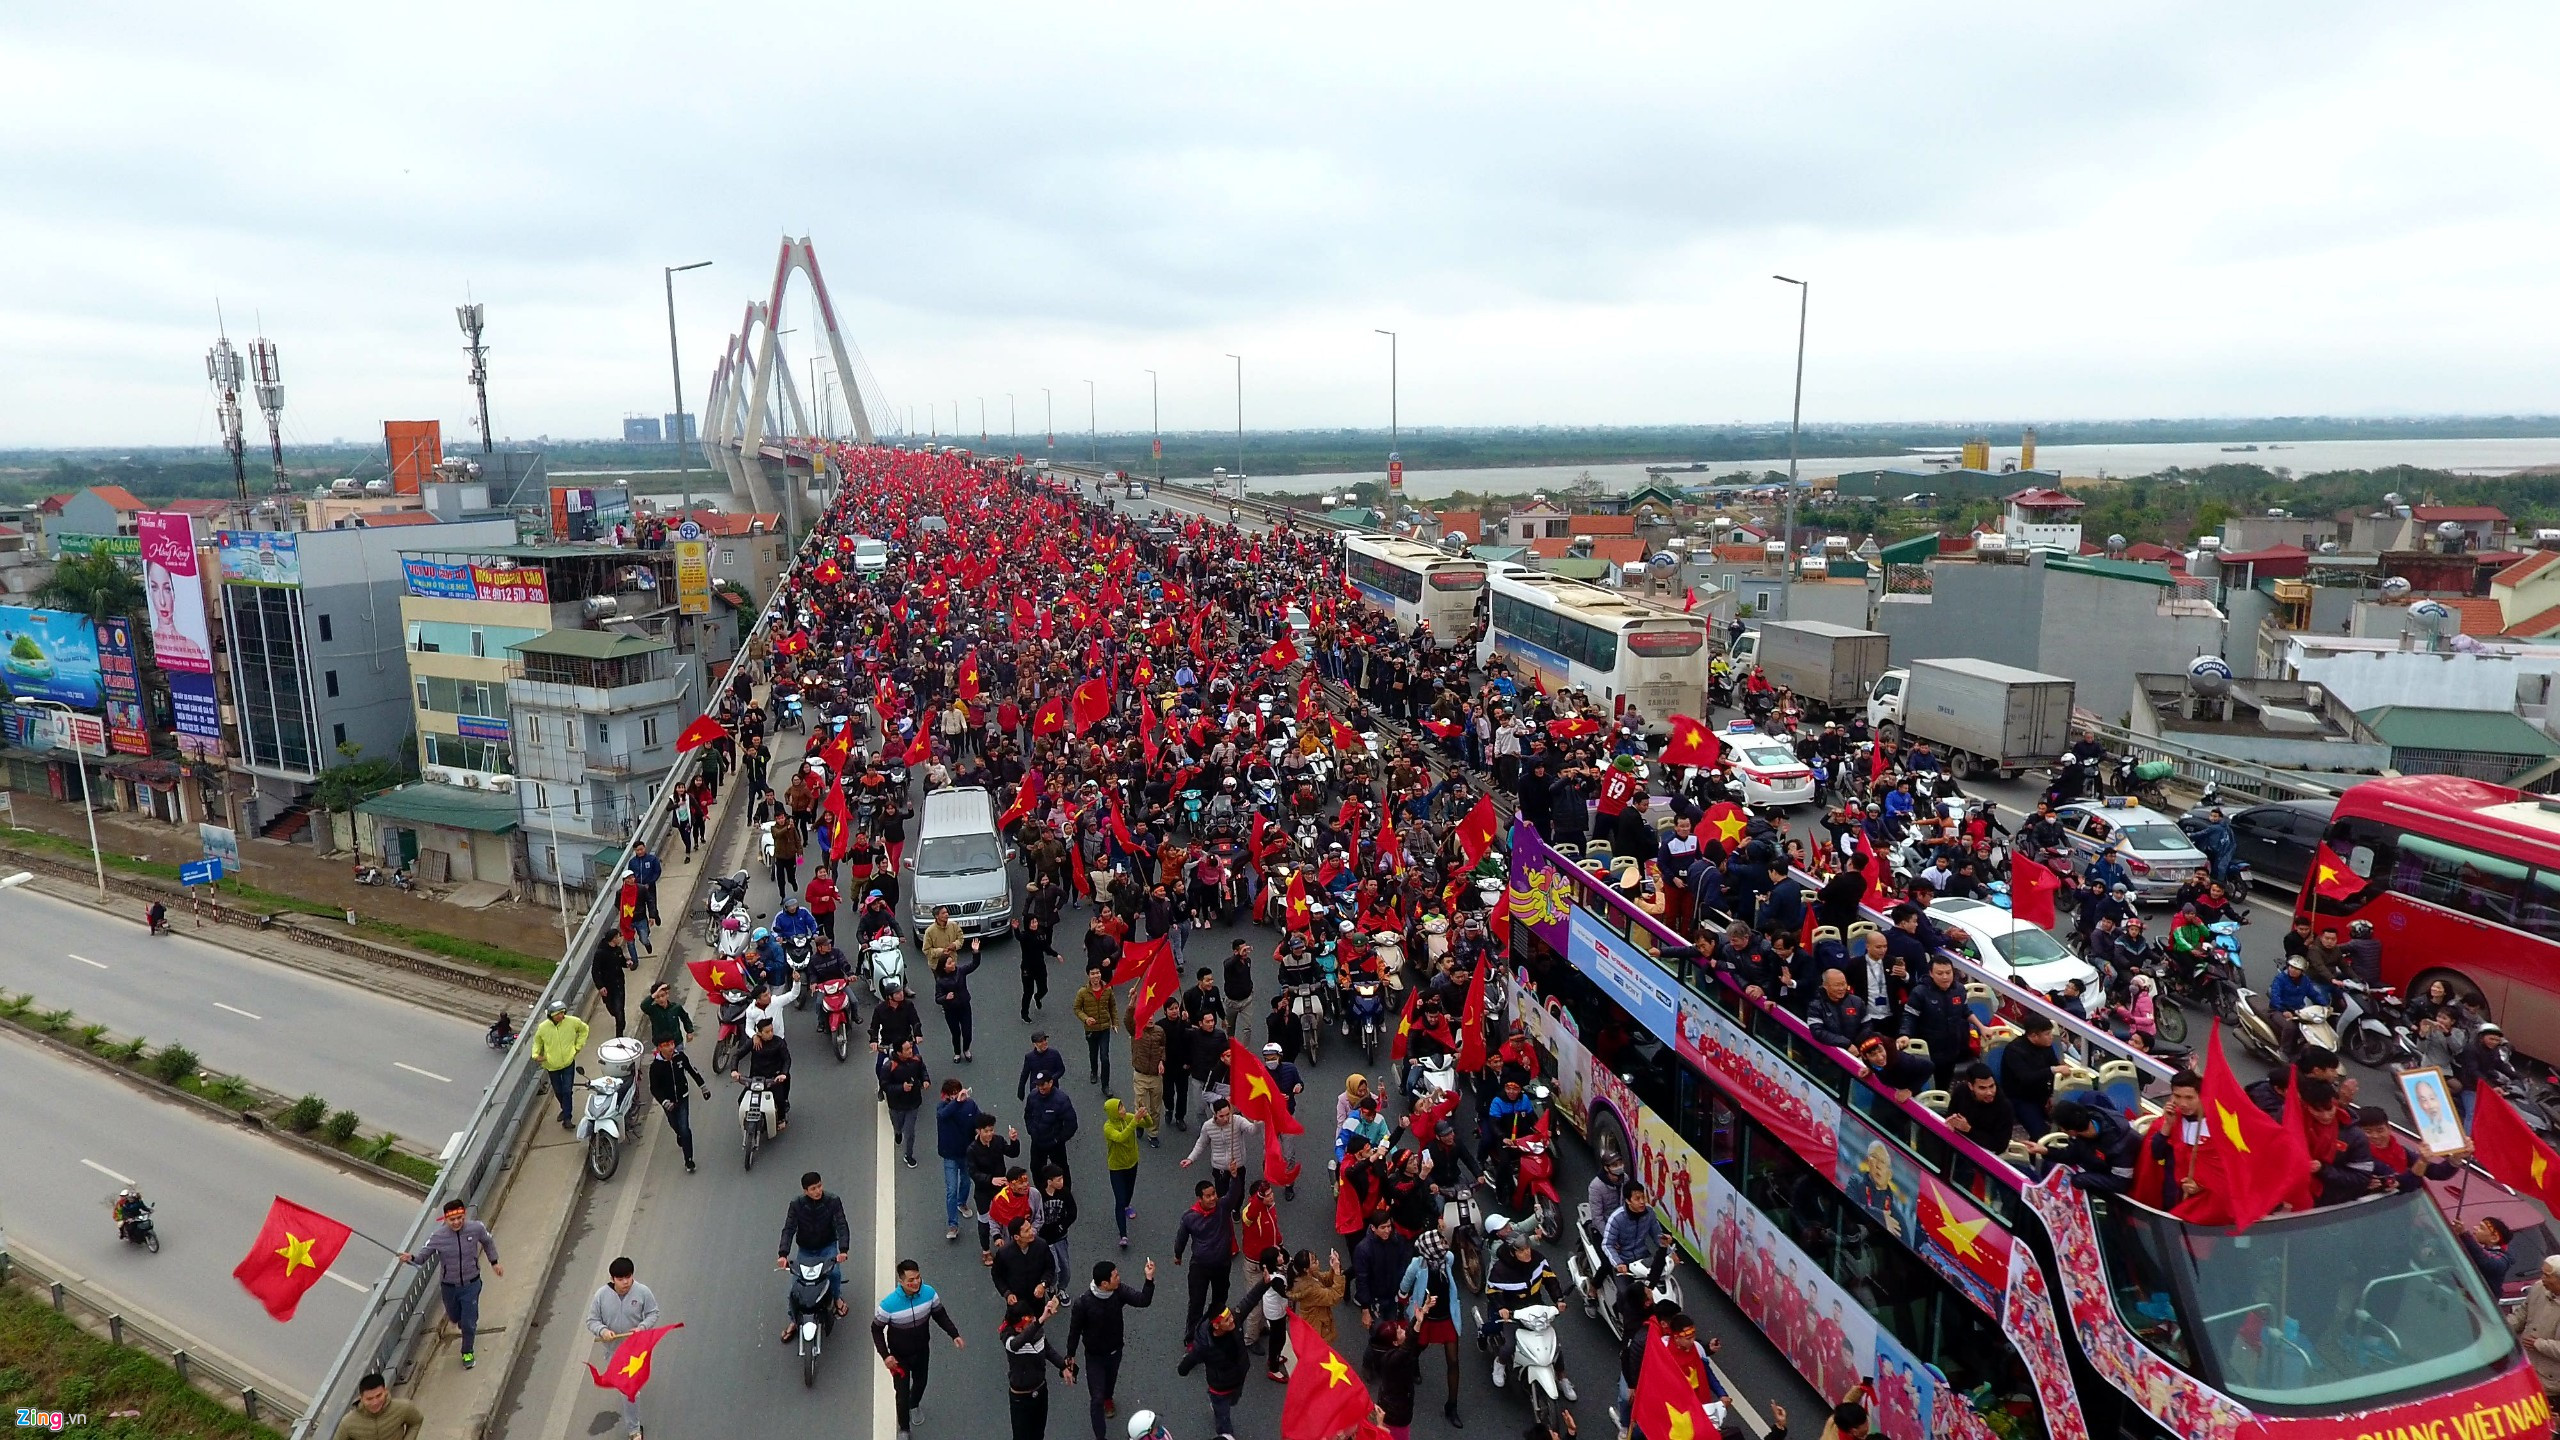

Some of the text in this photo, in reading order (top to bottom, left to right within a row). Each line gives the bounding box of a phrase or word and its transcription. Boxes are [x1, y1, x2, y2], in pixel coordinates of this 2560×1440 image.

[1607, 778, 1626, 799] 19
[2357, 1419, 2450, 1440] ANG
[2503, 1392, 2551, 1434] NAM
